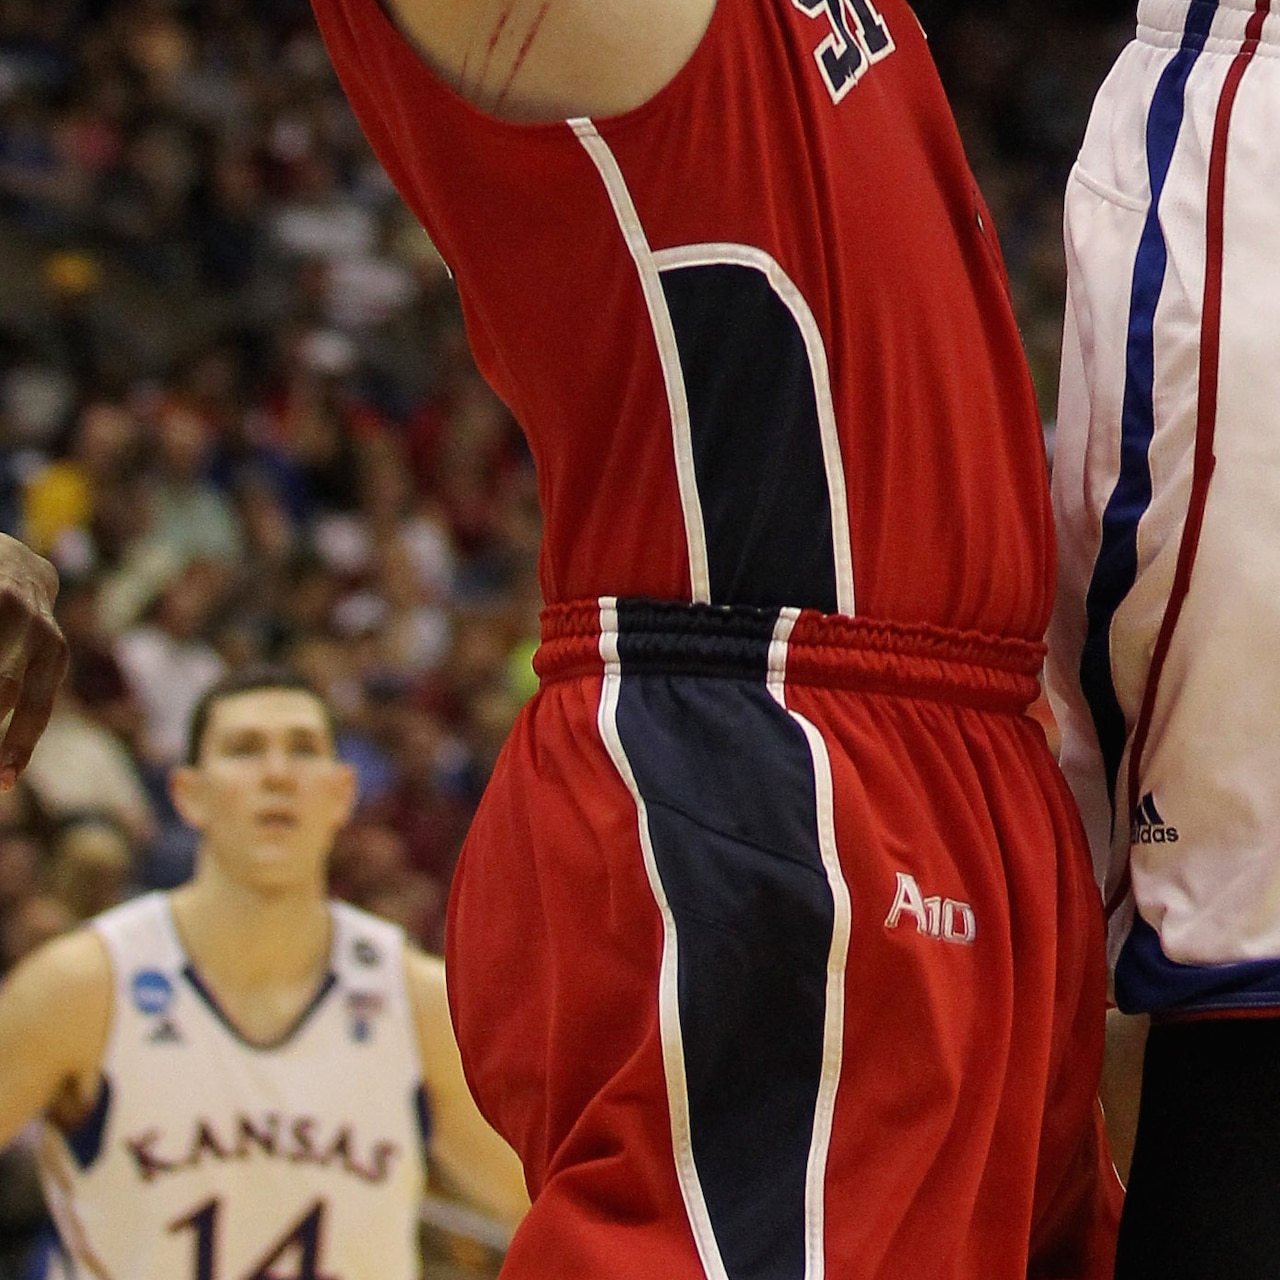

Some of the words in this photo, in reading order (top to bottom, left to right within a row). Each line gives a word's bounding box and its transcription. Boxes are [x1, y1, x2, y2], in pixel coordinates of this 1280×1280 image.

[1131, 819, 1179, 844] idas
[884, 871, 977, 945] A10
[126, 1110, 399, 1184] KANSAS
[167, 1193, 348, 1280] 14
